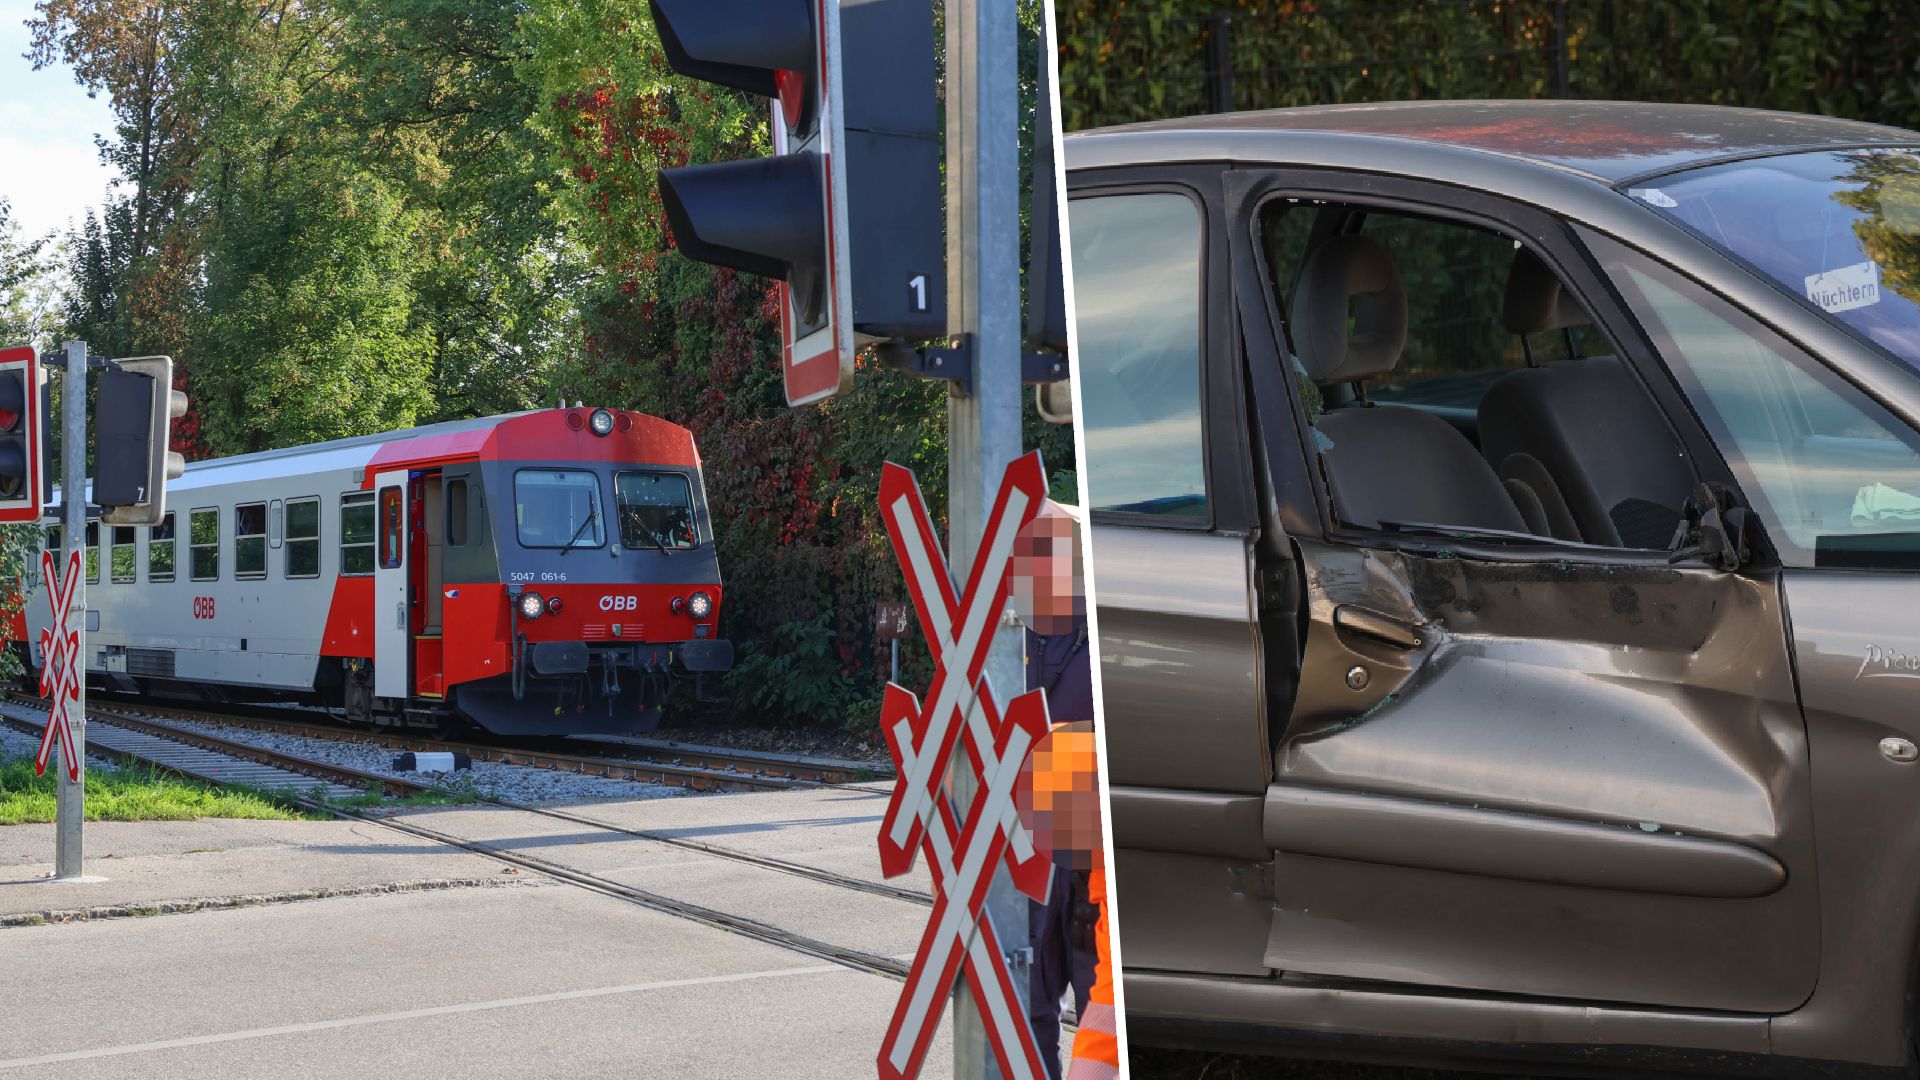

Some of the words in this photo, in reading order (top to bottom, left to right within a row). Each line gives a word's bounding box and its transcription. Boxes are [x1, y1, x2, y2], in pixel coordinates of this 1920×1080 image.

[909, 275, 926, 310] 1
[1811, 283, 1875, 306] Nüchtern
[137, 487, 145, 501] 7
[510, 572, 535, 581] 5047
[541, 572, 567, 581] 061-6
[193, 596, 215, 619] ÖBB
[599, 595, 638, 611] ÖBB
